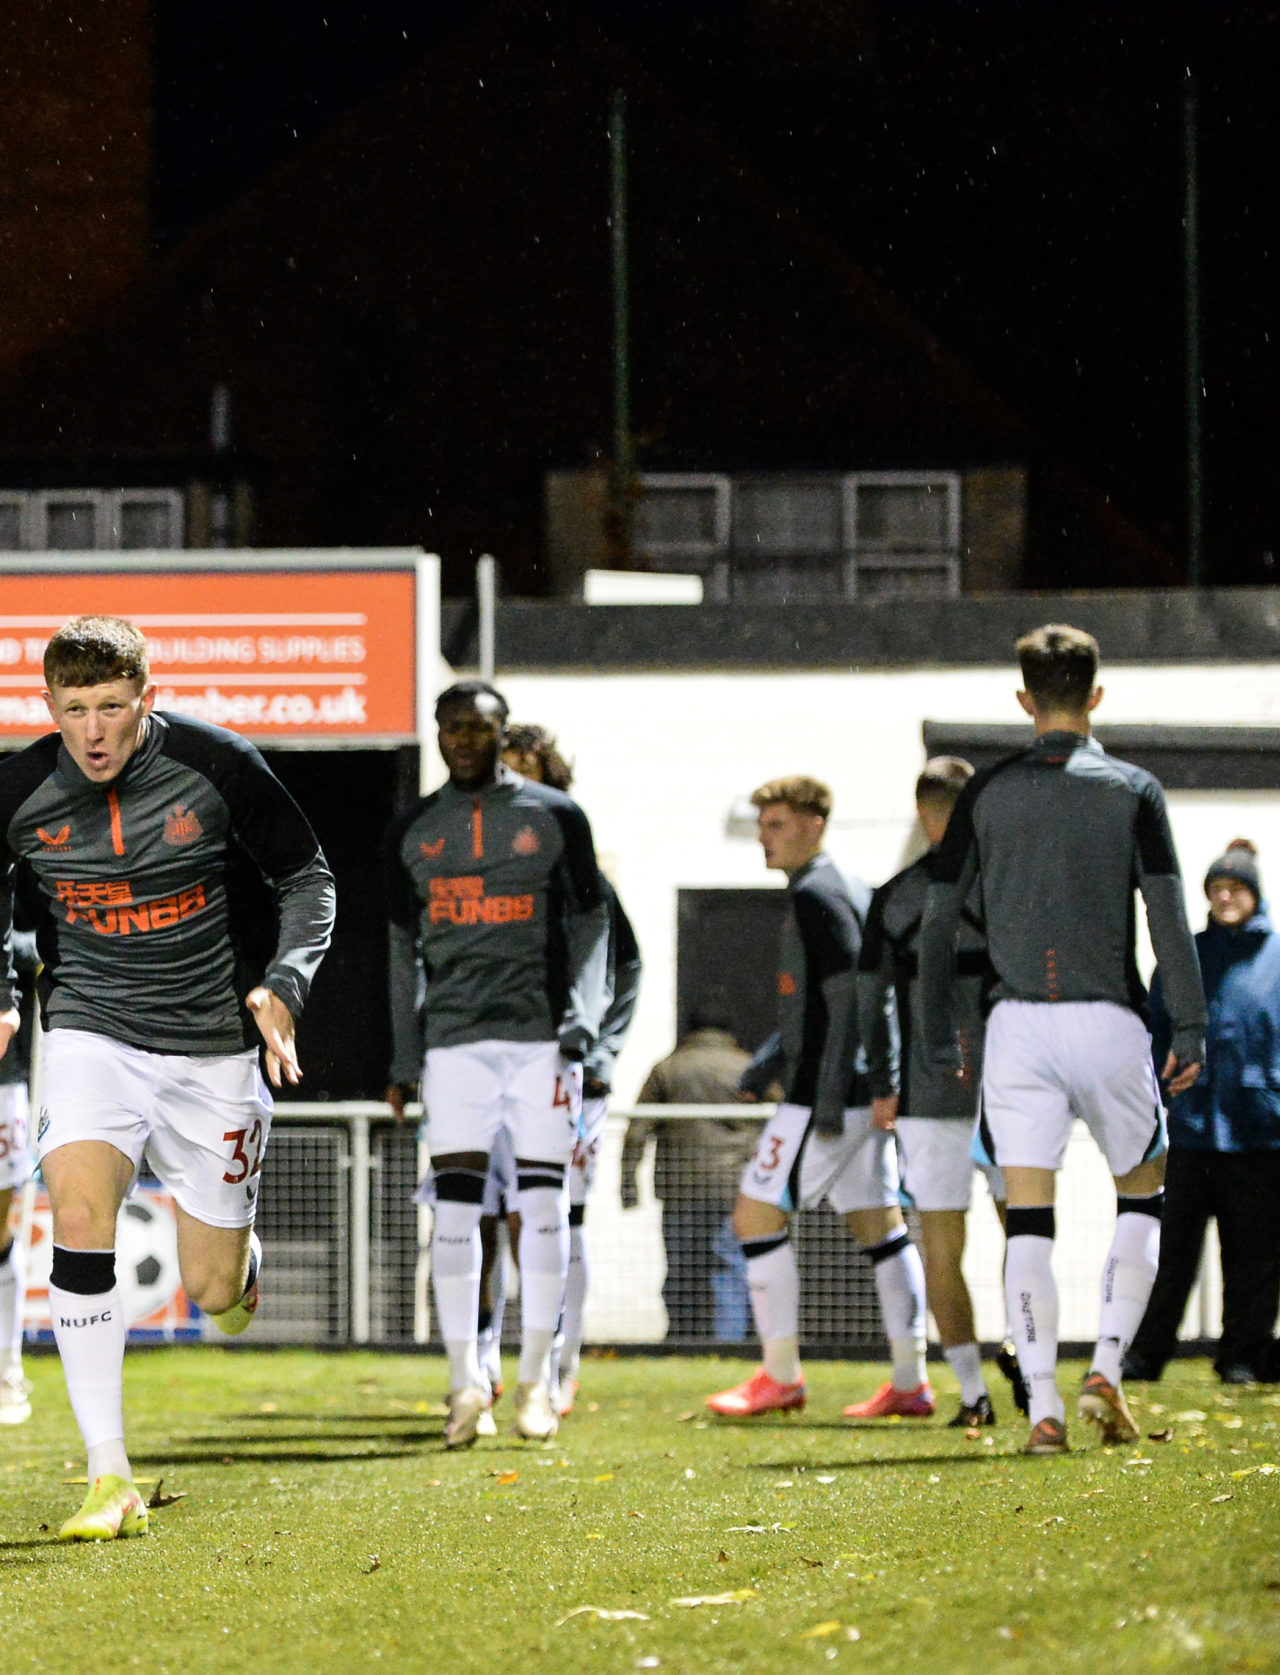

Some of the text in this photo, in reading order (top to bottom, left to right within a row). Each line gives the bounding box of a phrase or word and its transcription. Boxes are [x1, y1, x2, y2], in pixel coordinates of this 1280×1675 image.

[258, 635, 367, 664] SUPPLIES
[429, 894, 534, 925] FUN88
[223, 1119, 262, 1184] 32
[60, 1310, 112, 1328] NUFC
